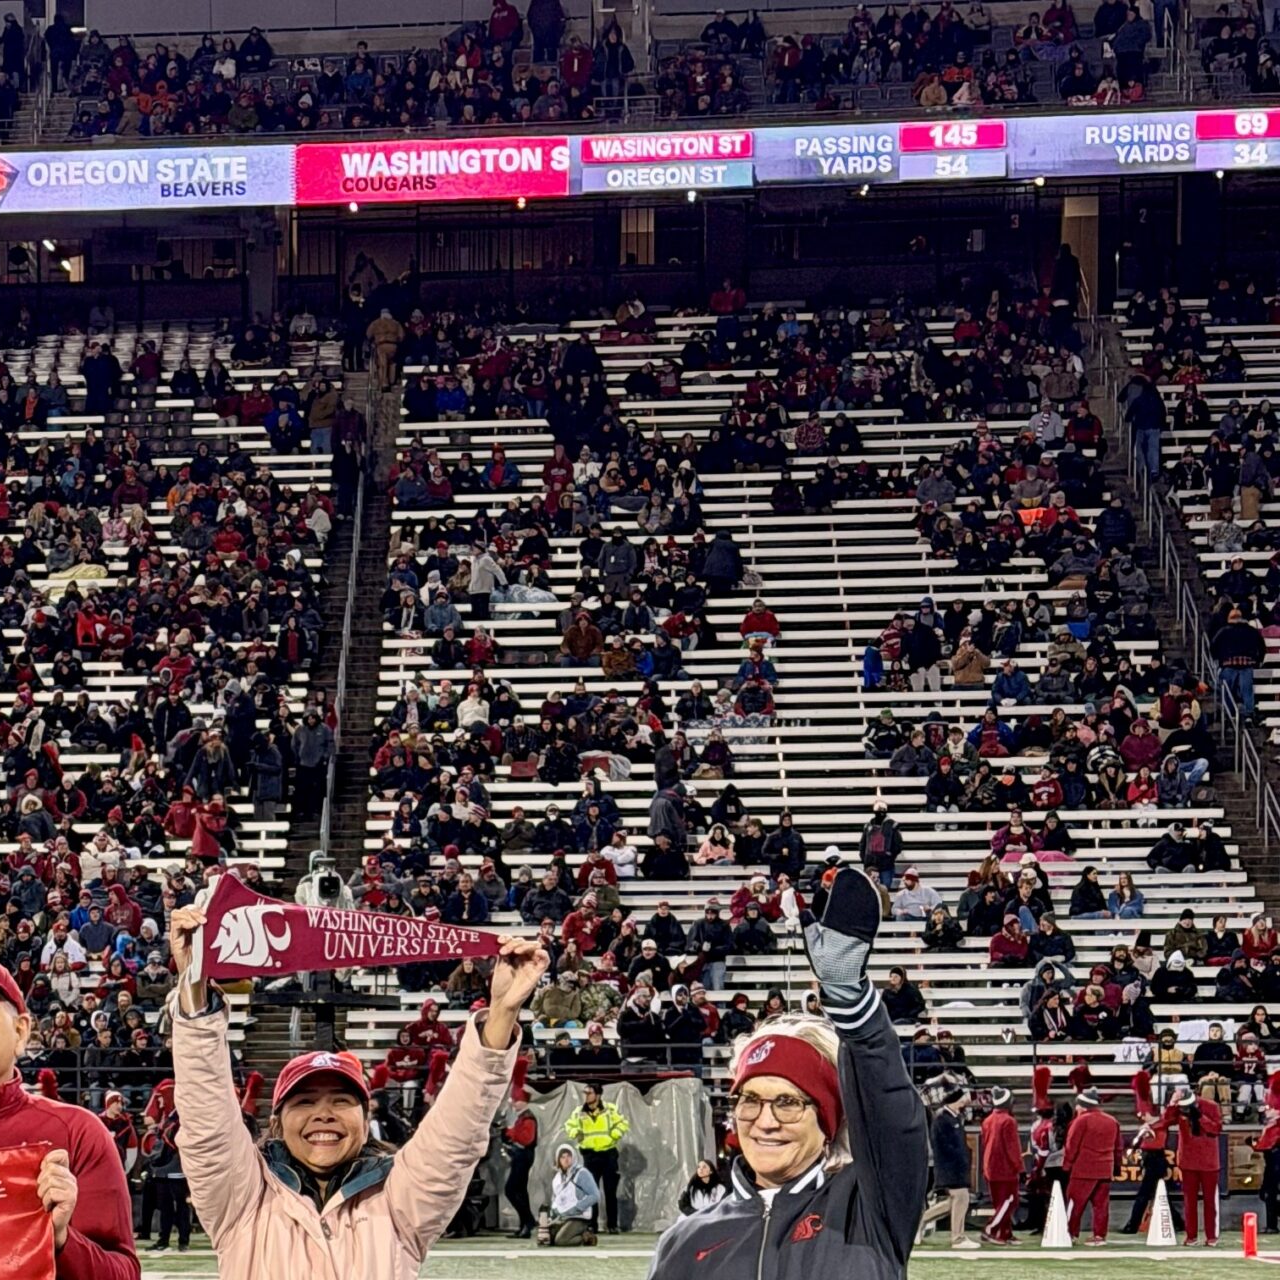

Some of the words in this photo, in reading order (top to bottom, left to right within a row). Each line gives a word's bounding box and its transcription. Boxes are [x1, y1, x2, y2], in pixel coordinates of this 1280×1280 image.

[1085, 123, 1191, 145] RUSHING
[1234, 112, 1269, 136] 69
[718, 135, 746, 153] ST
[795, 135, 893, 156] PASSING
[929, 125, 978, 147] 145
[341, 147, 542, 177] WASHINGTON
[550, 146, 570, 172] S
[1115, 143, 1190, 164] YARDS
[1233, 142, 1268, 164] 34
[27, 159, 148, 187] OREGON
[156, 156, 248, 183] STATE
[607, 166, 695, 187] OREGON
[700, 165, 727, 183] ST
[820, 155, 893, 175] YARDS
[935, 154, 969, 176] 54
[161, 181, 247, 198] BEAVERS
[342, 175, 437, 192] COUGARS
[306, 907, 423, 939] WASHINGTON
[428, 924, 480, 943] STATE
[324, 931, 458, 961] UNIVERSITY
